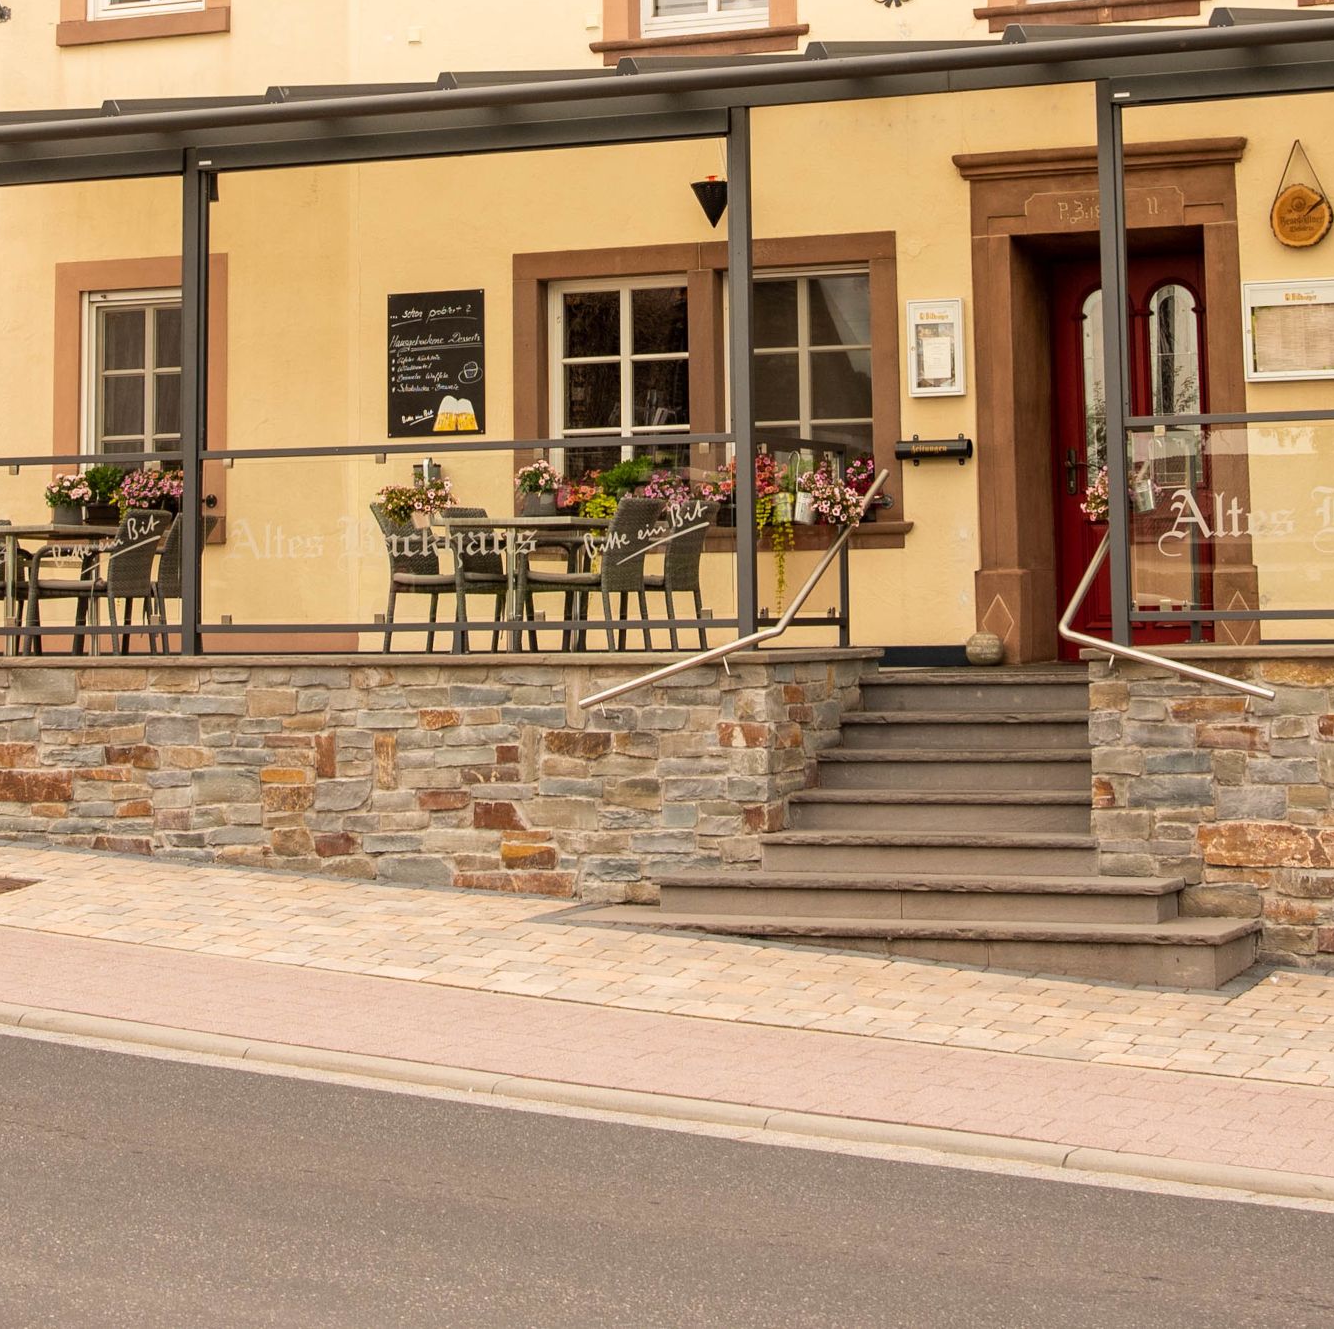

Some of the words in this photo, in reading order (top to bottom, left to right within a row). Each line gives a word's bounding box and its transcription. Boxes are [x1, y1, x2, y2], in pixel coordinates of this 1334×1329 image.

[51, 545, 93, 567] Bitte
[98, 537, 124, 552] ein
[127, 514, 160, 541] Bit
[226, 517, 325, 575] Altes
[337, 515, 538, 575] Backhaus
[583, 527, 630, 561] Bitte
[636, 522, 667, 542] ein
[667, 500, 707, 532] Bit
[1157, 486, 1296, 558] Altes
